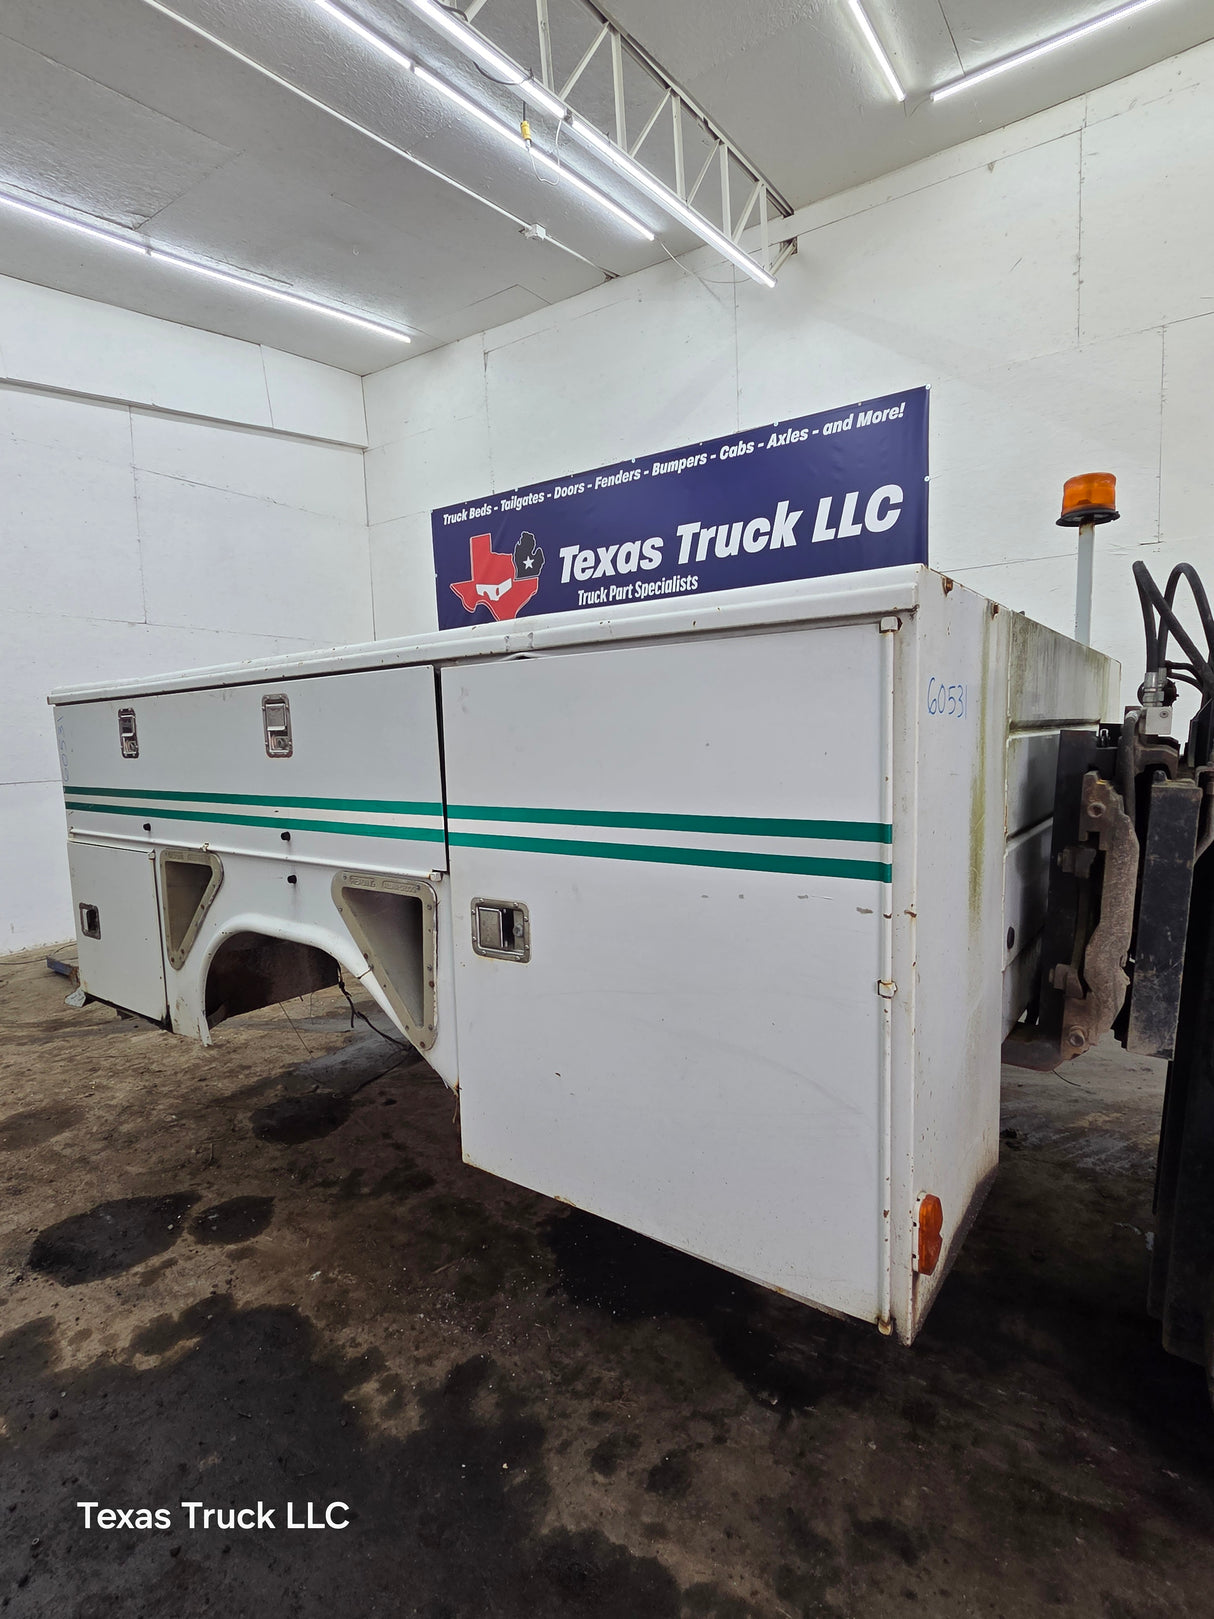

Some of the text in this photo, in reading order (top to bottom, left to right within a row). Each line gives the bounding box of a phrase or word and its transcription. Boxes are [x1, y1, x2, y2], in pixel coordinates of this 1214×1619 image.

[443, 509, 468, 526] Truck
[469, 504, 492, 520] Beds
[500, 491, 545, 512] Tailgates
[554, 482, 585, 500] Doors
[594, 469, 642, 490] Fenders
[651, 452, 708, 477] Bumpers
[720, 440, 755, 460] Cabs
[766, 426, 809, 449] Axles
[822, 413, 854, 436] and
[856, 402, 906, 429] More!
[559, 484, 904, 584] Texas Truck LLC
[577, 574, 699, 606] Truck Part Specialists
[927, 676, 968, 721] 60531
